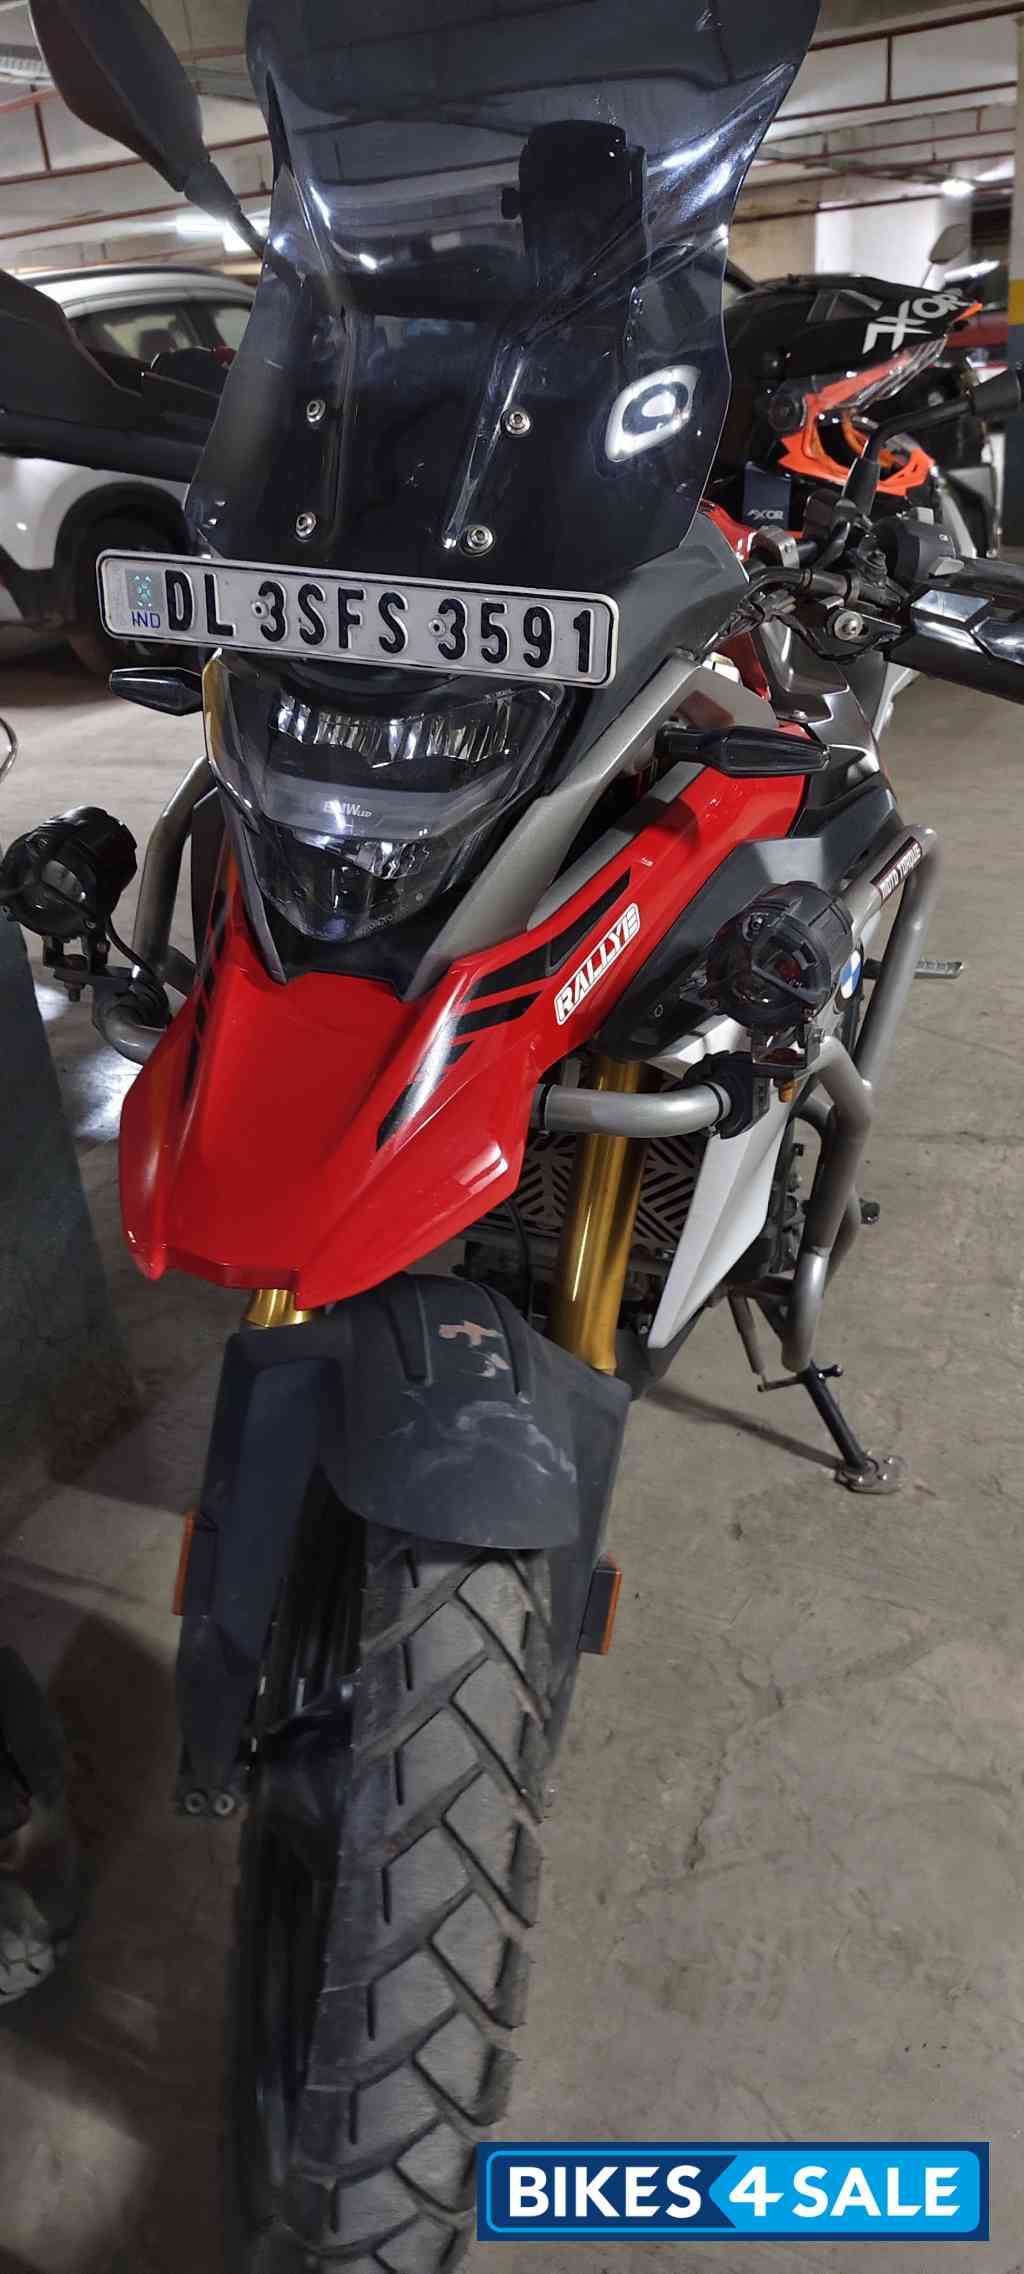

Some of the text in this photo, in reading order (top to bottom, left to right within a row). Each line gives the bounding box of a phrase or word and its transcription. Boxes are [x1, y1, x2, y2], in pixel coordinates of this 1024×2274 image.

[131, 610, 161, 629] IND
[165, 569, 594, 674] DL 3SFS 3591
[556, 905, 639, 1022] RALLYE
